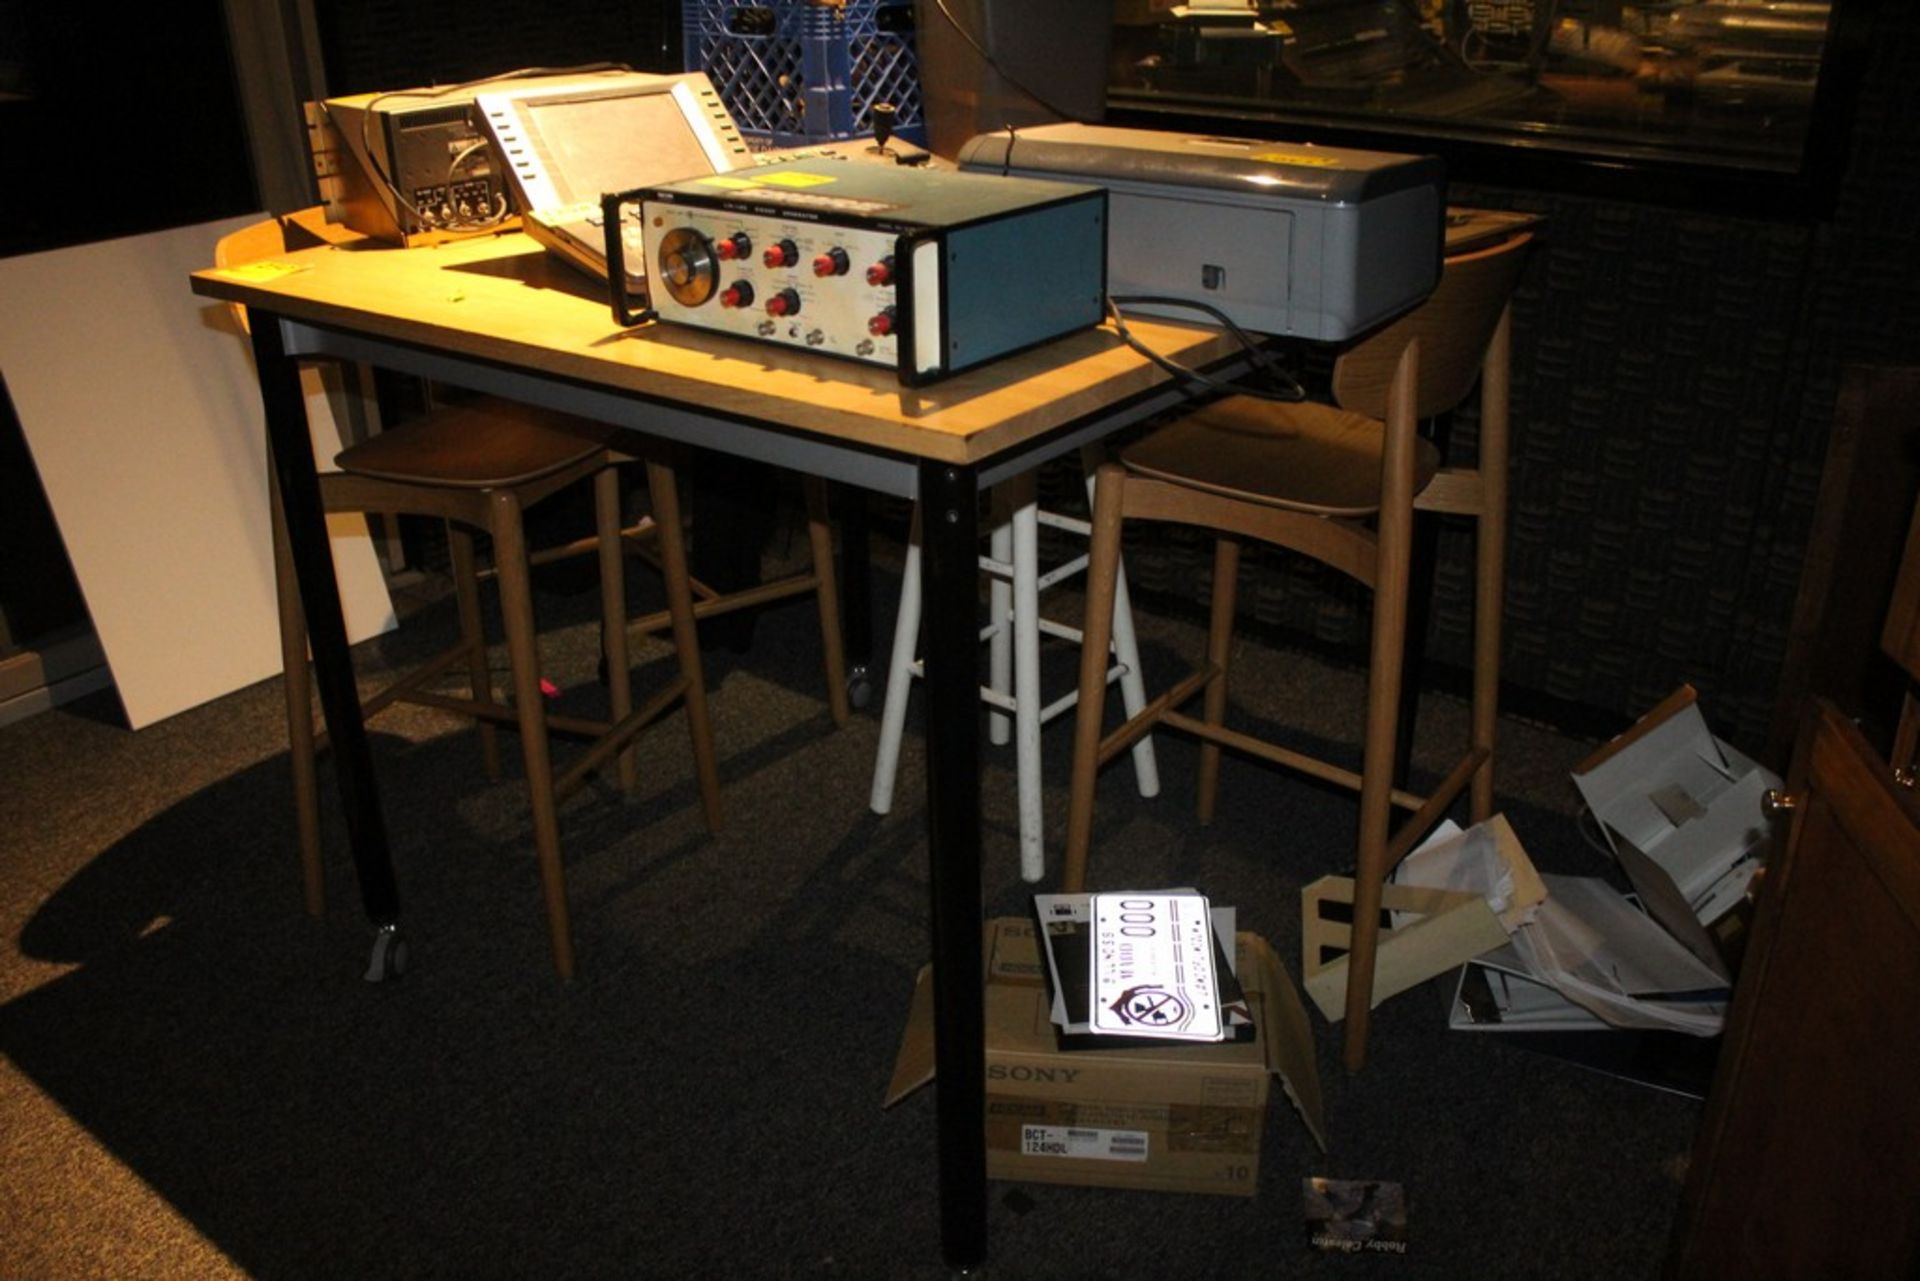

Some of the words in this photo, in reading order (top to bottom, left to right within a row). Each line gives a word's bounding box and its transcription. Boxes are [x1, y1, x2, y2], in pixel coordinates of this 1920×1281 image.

[1119, 900, 1156, 937] 000
[988, 1065, 1080, 1083] SONY
[1025, 1129, 1053, 1140] BCT-
[1025, 1142, 1067, 1154] 124HDL
[1226, 1165, 1248, 1179] 10
